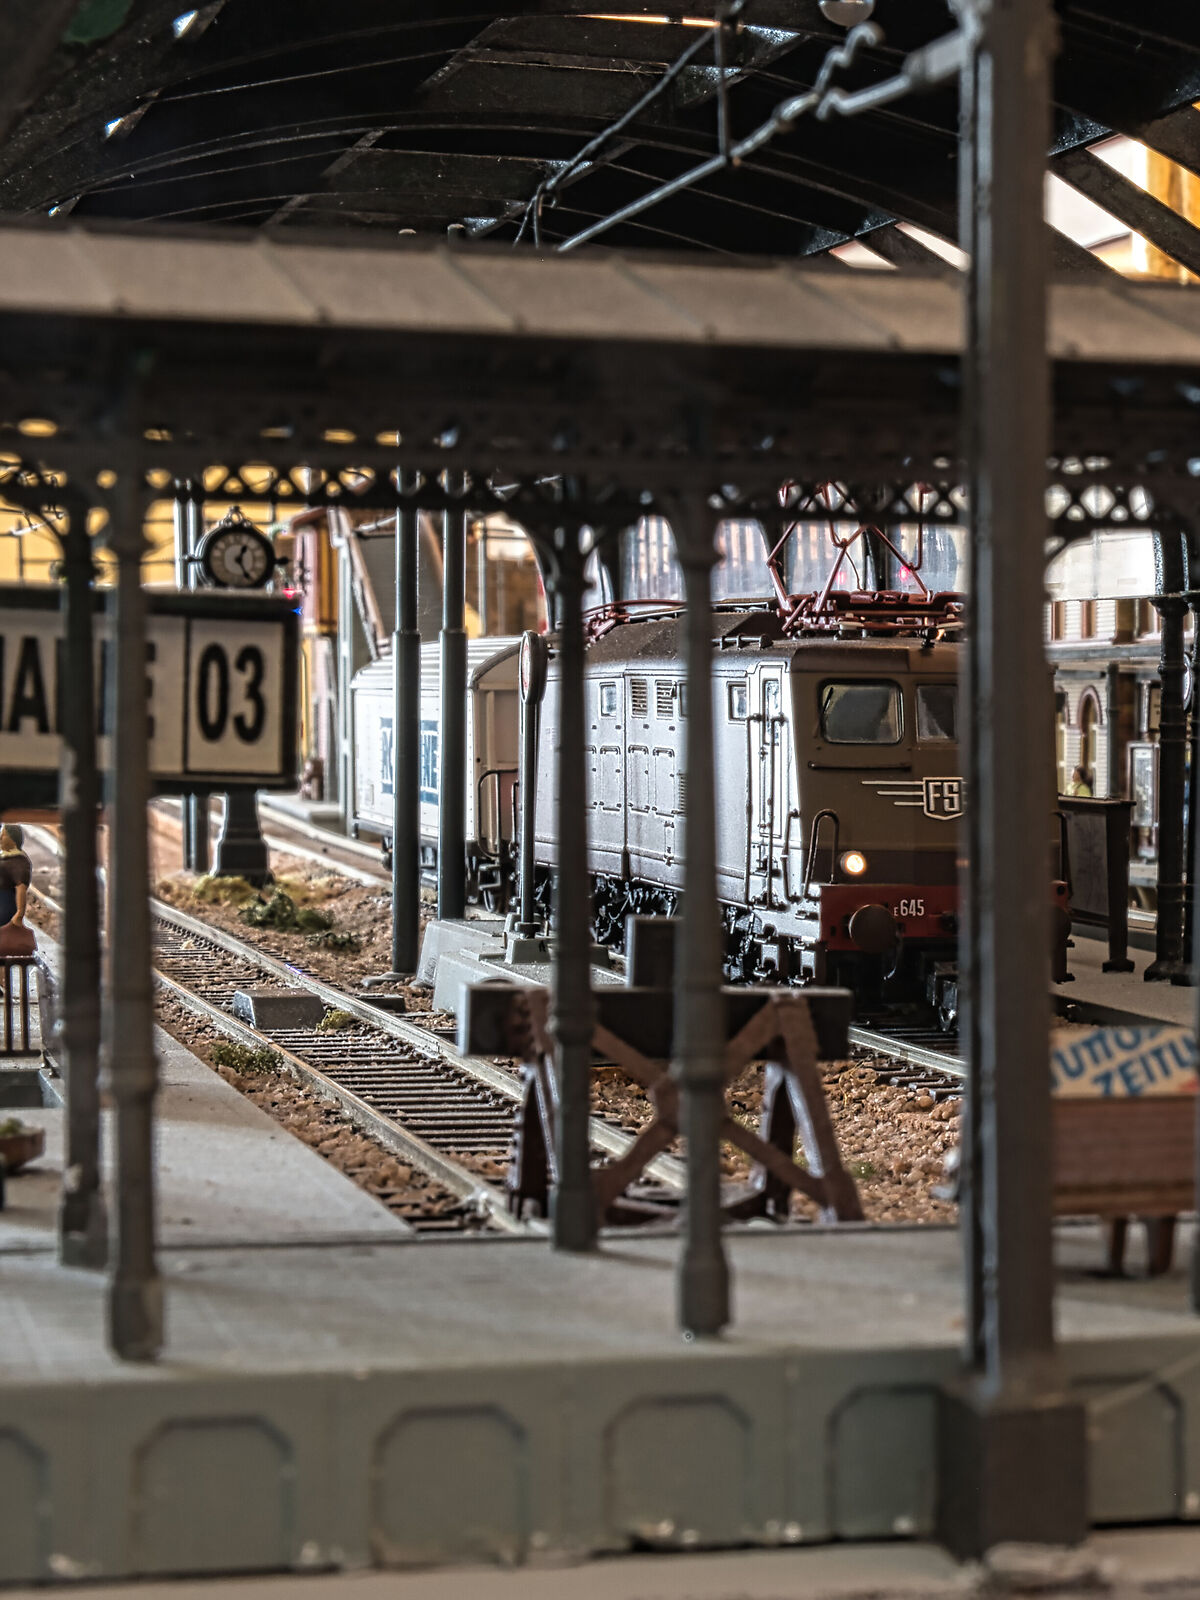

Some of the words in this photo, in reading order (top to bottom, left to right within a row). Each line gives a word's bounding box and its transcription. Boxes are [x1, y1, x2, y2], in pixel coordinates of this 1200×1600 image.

[197, 642, 266, 745] 03
[927, 781, 960, 812] FS
[1092, 1033, 1200, 1097] ZEITU
